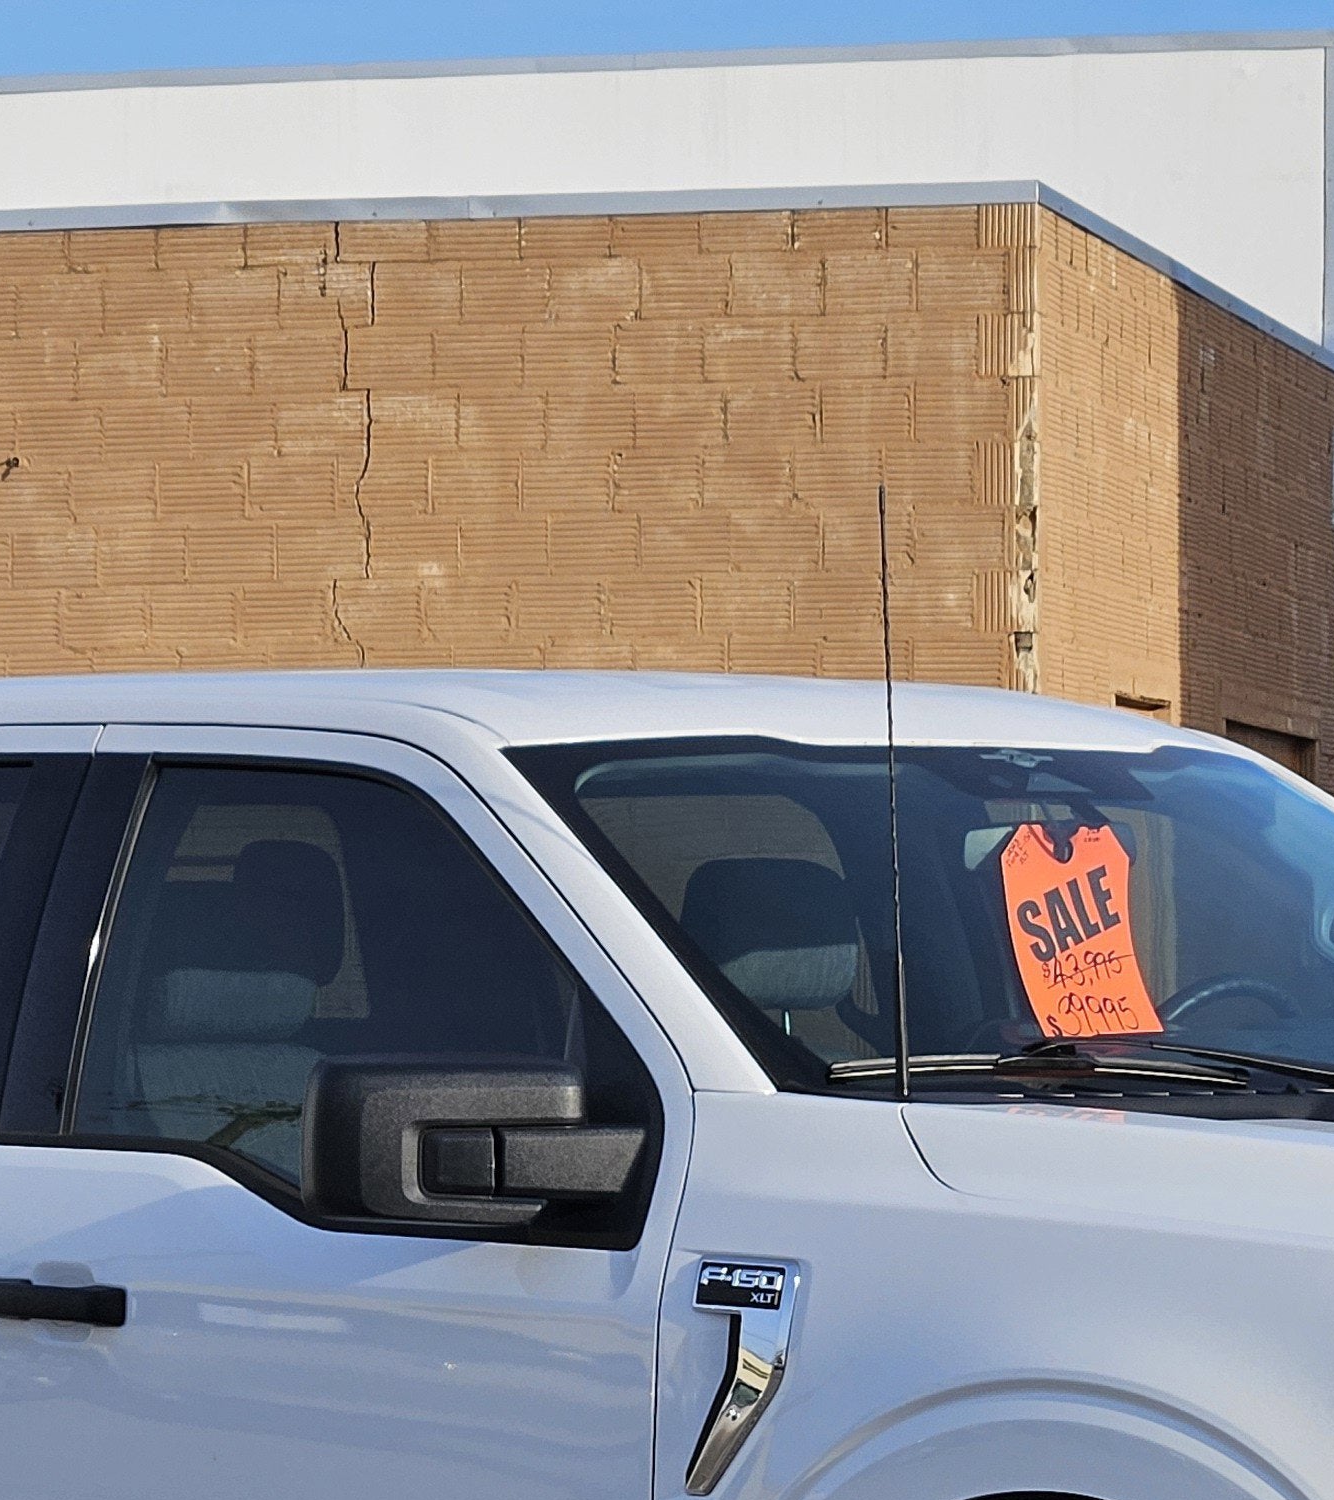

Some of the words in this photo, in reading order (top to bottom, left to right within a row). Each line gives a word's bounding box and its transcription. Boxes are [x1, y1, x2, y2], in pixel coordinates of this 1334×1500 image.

[1017, 864, 1122, 963] SALE
[700, 1266, 784, 1291] F-150
[750, 1291, 776, 1304] XLT
